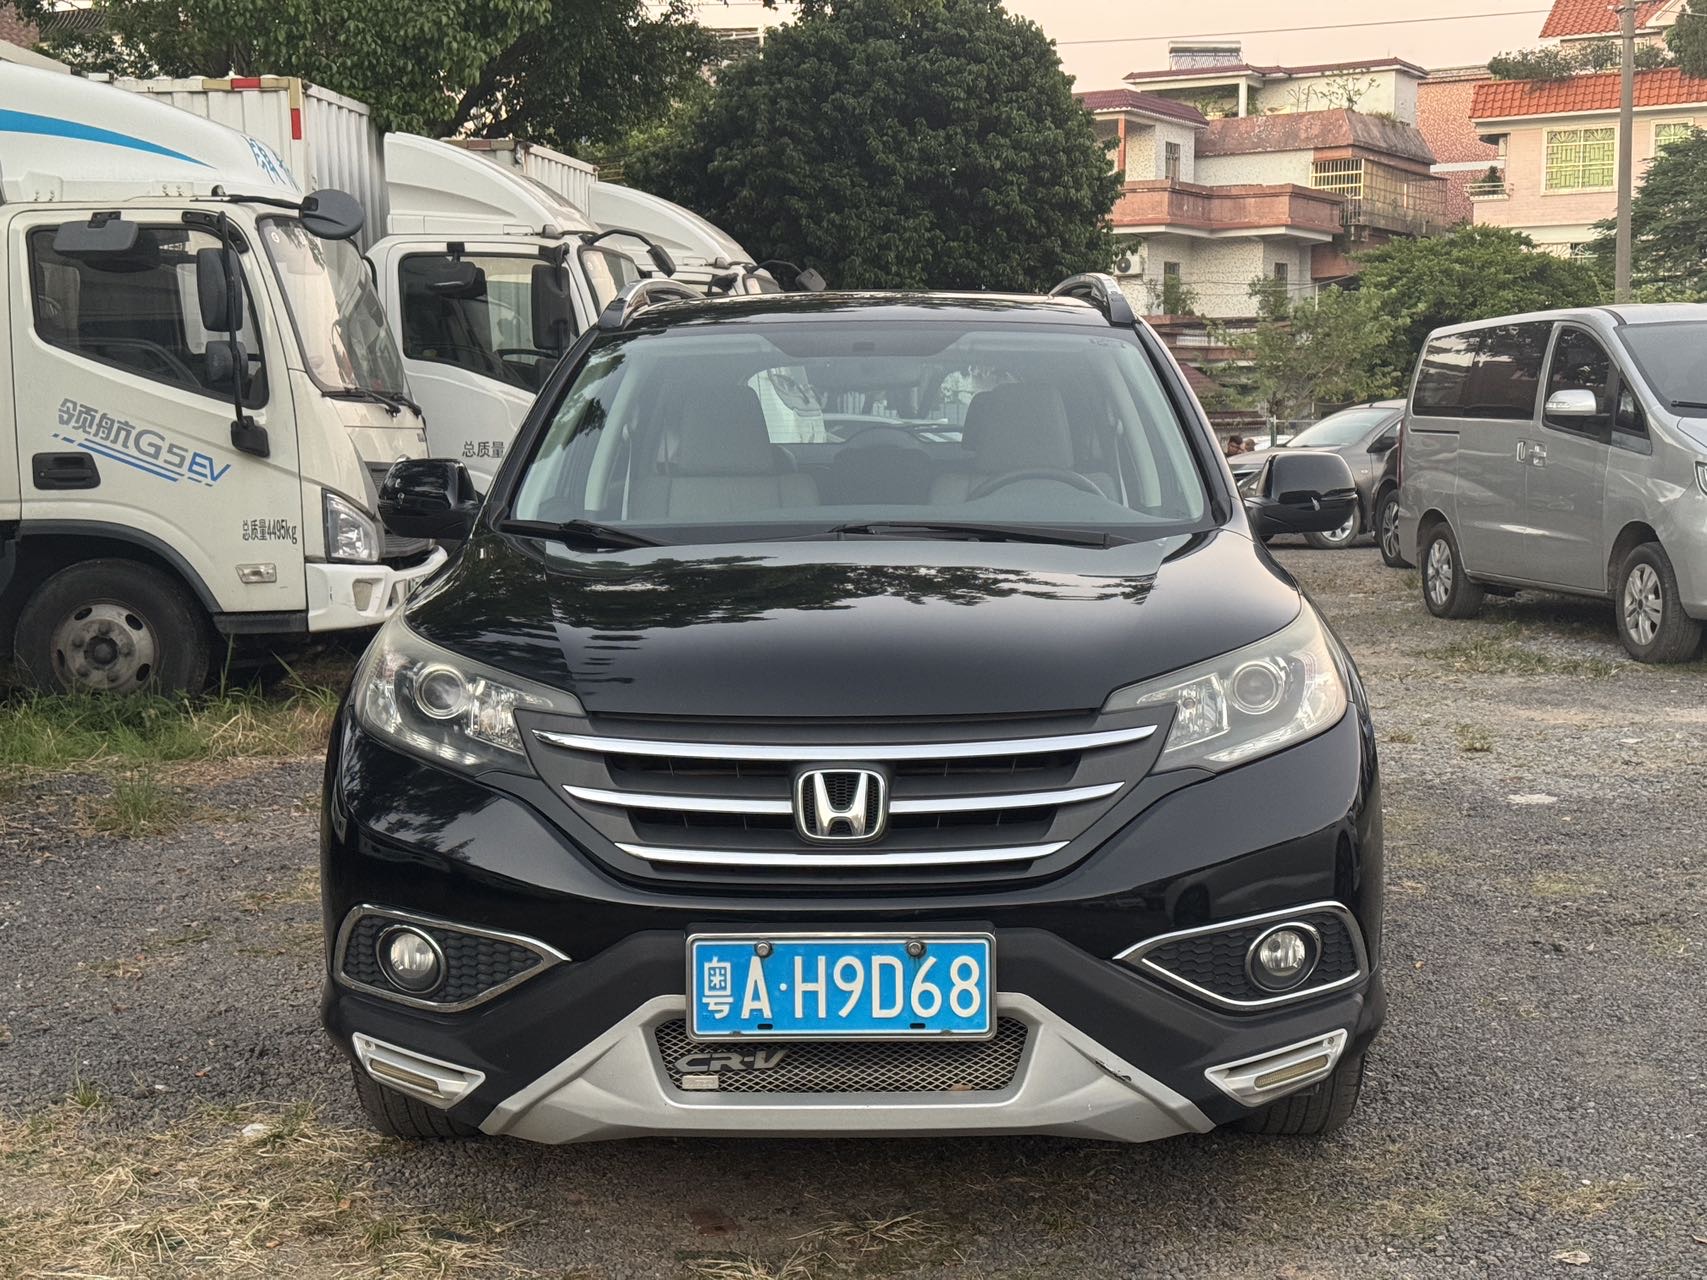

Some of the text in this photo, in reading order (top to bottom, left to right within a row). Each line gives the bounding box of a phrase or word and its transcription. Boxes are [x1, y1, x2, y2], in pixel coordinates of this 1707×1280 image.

[462, 440, 504, 459] 总质量
[242, 519, 298, 545] 总质量4495kg
[702, 955, 982, 1020] 粤A·H9D68
[674, 1049, 789, 1072] CR-V
